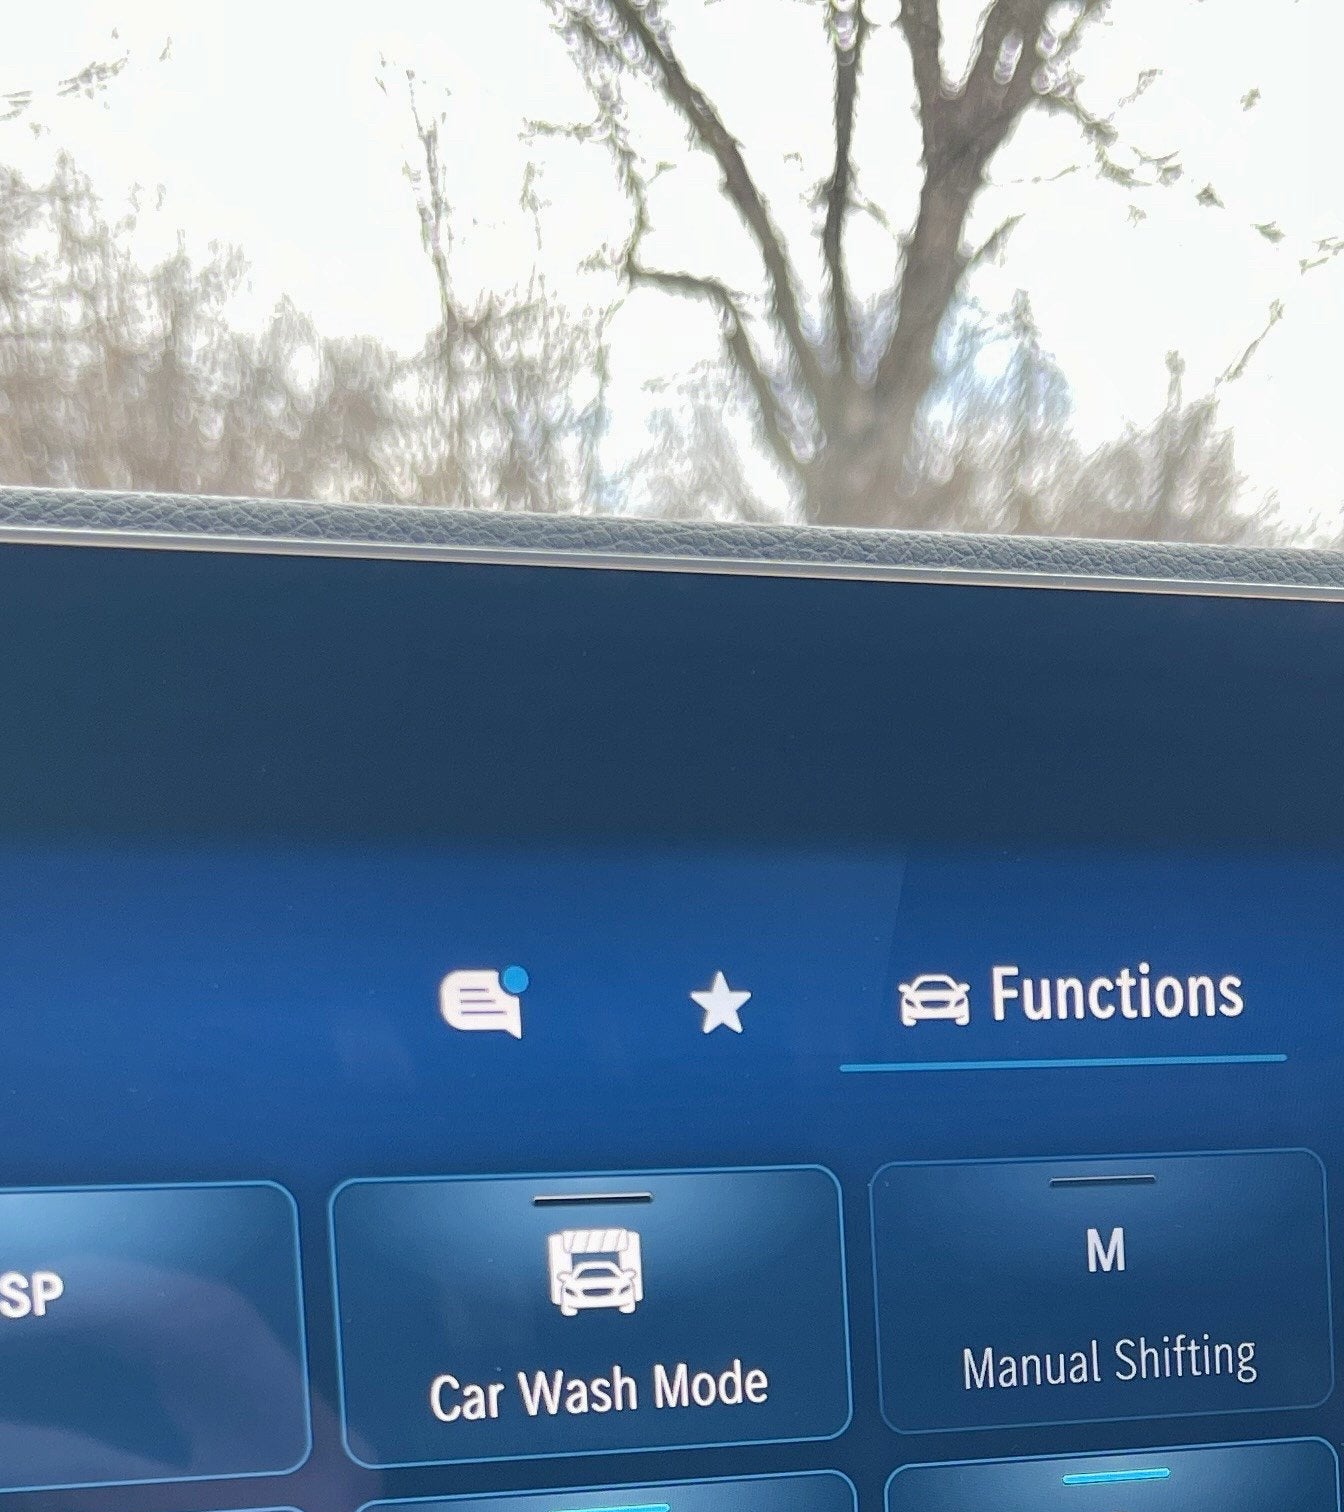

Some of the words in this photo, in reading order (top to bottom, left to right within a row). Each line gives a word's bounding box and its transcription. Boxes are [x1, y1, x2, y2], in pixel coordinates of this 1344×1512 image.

[992, 961, 1244, 1021] Functions
[1086, 1226, 1125, 1273] M
[430, 1374, 505, 1422] Car
[517, 1365, 638, 1417] Wash
[653, 1358, 768, 1409] Mode
[963, 1339, 1102, 1390] Manual
[1115, 1333, 1257, 1383] Shifting
